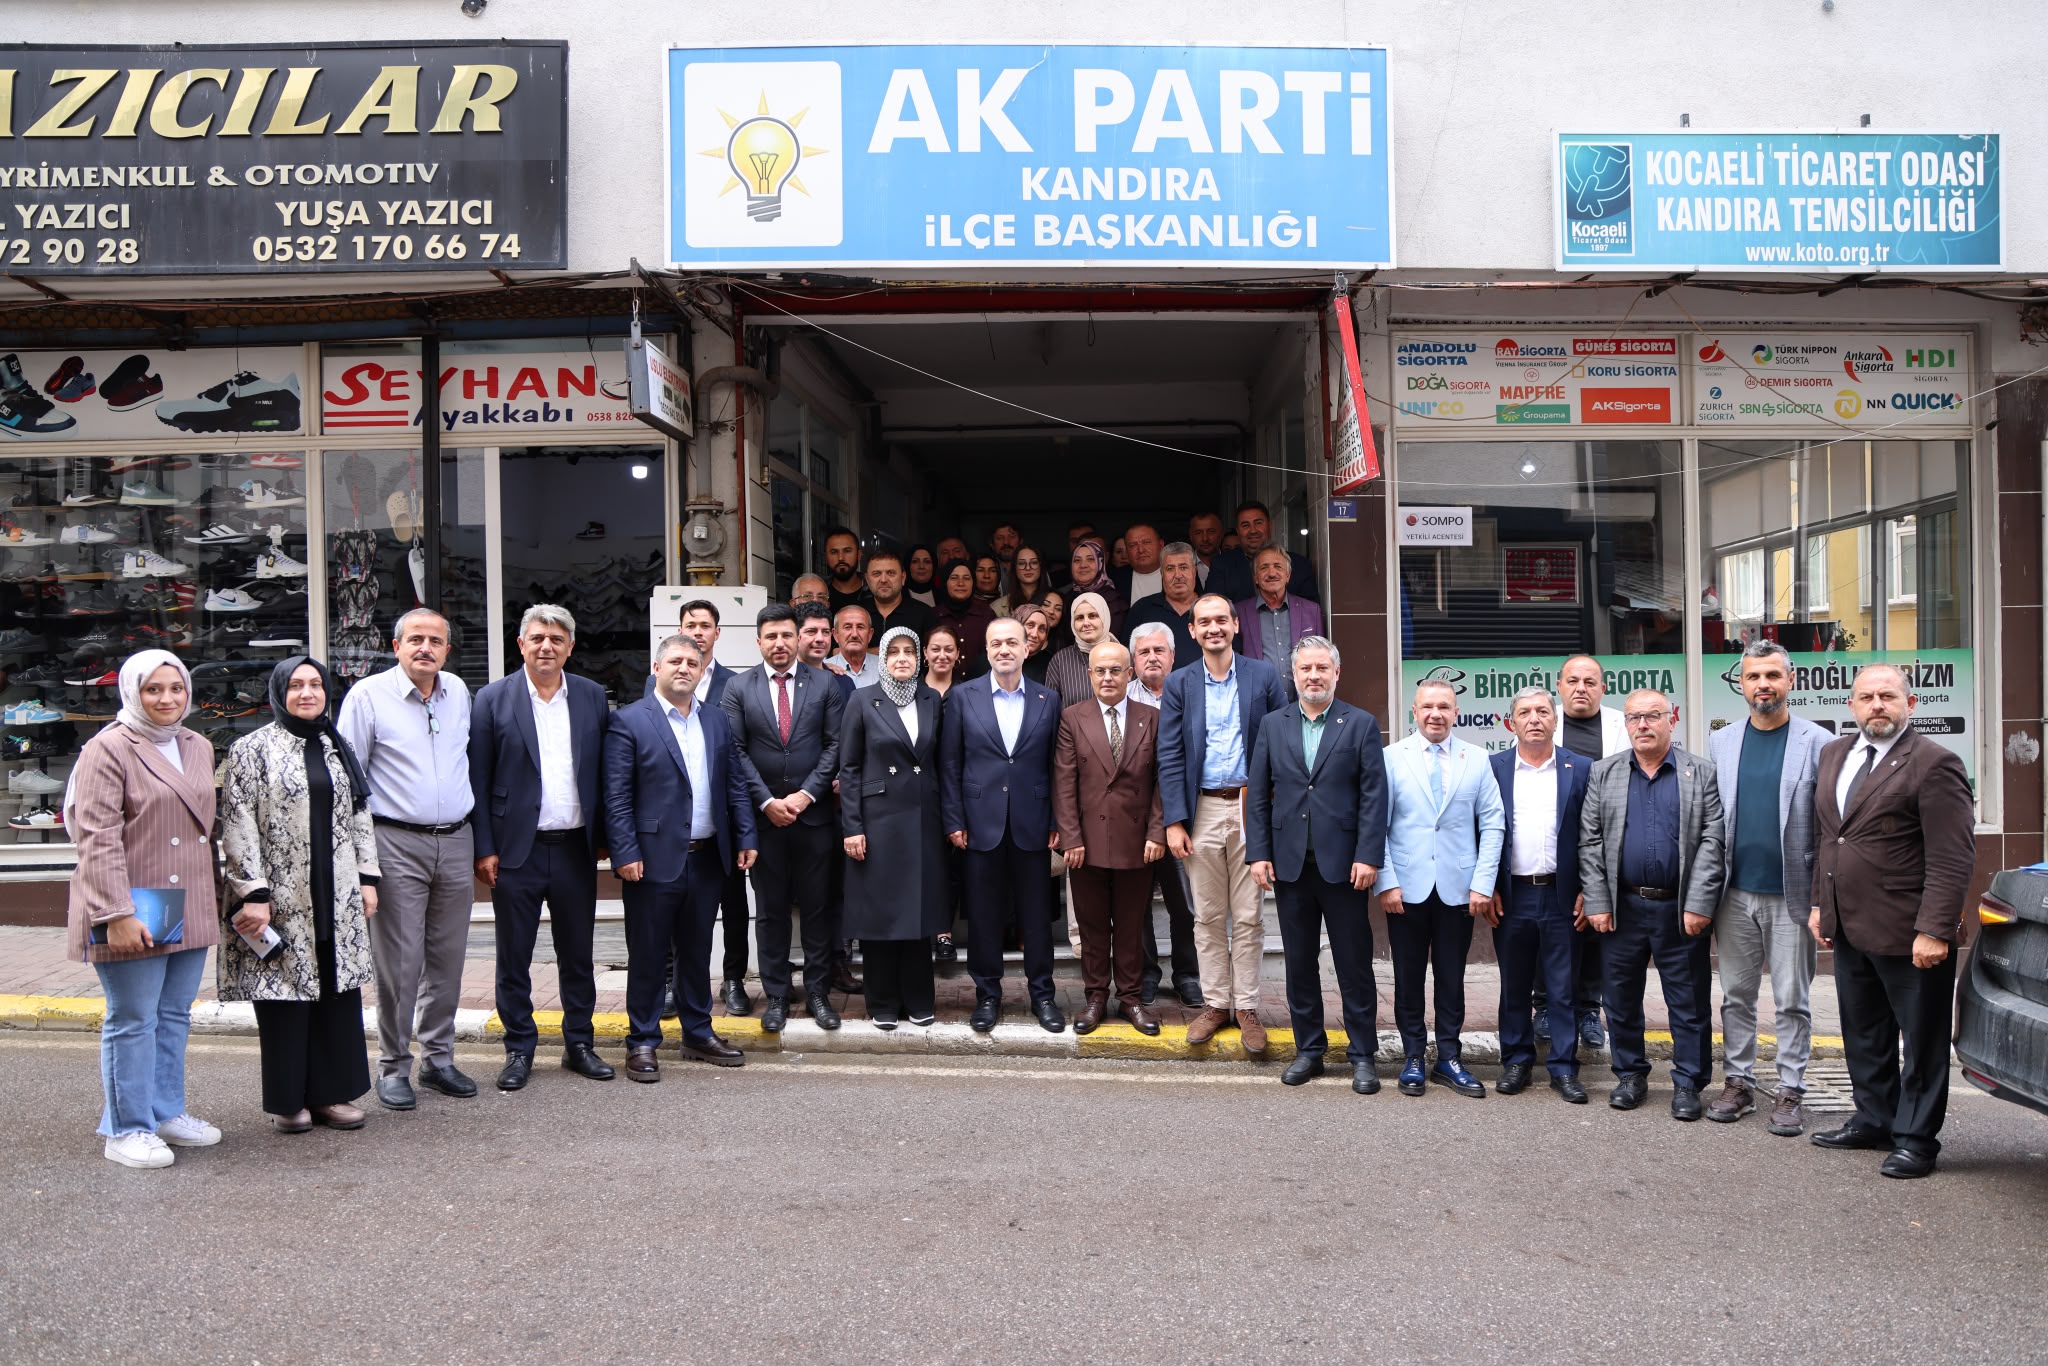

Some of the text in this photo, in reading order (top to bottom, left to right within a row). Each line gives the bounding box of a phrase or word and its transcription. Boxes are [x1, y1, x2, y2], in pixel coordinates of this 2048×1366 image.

[0, 64, 518, 138] ZICILAR
[867, 68, 1371, 155] AK PARTİ
[1646, 143, 1984, 186] KOCAELİ TİCARET ODASI
[207, 165, 238, 186] &
[244, 163, 439, 186] OTOMOTIV
[1022, 167, 1221, 201] KANDIRA
[15, 203, 130, 229] YAZICI
[275, 200, 493, 233] YUŞA YAZICI
[1657, 189, 1976, 232] KANDIRA TEMSİLCİLİĞİ
[1034, 210, 1317, 249] BAŞKANLIĞI
[1571, 221, 1627, 237] Kocaeli
[43, 238, 85, 264] 90
[97, 237, 139, 263] 28
[252, 233, 521, 262] 0532 170 66 74
[1591, 244, 1609, 252] 1897
[1746, 243, 1890, 265] www.koto.org.tr
[1397, 344, 1477, 353] ANADOLU
[1496, 345, 1567, 357] RAY SİGORTA
[1575, 340, 1673, 354] GÜNEŞ SİGORTA
[1775, 345, 1837, 354] TÜRK NİPPON
[1397, 354, 1468, 366] SİGORTA
[1775, 356, 1810, 365] SİGORTA
[1844, 351, 1883, 361] Ankara
[1906, 349, 1955, 368] HDI
[1587, 364, 1677, 377] KORU SİGORTA
[1854, 361, 1894, 373] Sigorta
[1407, 373, 1449, 390] DOĞA
[1760, 378, 1833, 387] DEMİR SİGORTA
[1500, 386, 1566, 400] MAPFRE
[1591, 402, 1661, 412] AKSigorta
[1700, 403, 1733, 411] ZURICH
[1739, 401, 1824, 414] SBN SİGORTA
[1867, 400, 1886, 408] NN
[1891, 393, 1954, 410] QUICK
[587, 412, 612, 422] 0538
[1523, 412, 1566, 421] Groupama
[1699, 413, 1735, 421] SİGORTA
[1339, 506, 1346, 516] 17
[1422, 516, 1463, 526] SOMPO
[1475, 666, 1561, 699] BİROĞL
[1453, 713, 1494, 728] UICK
